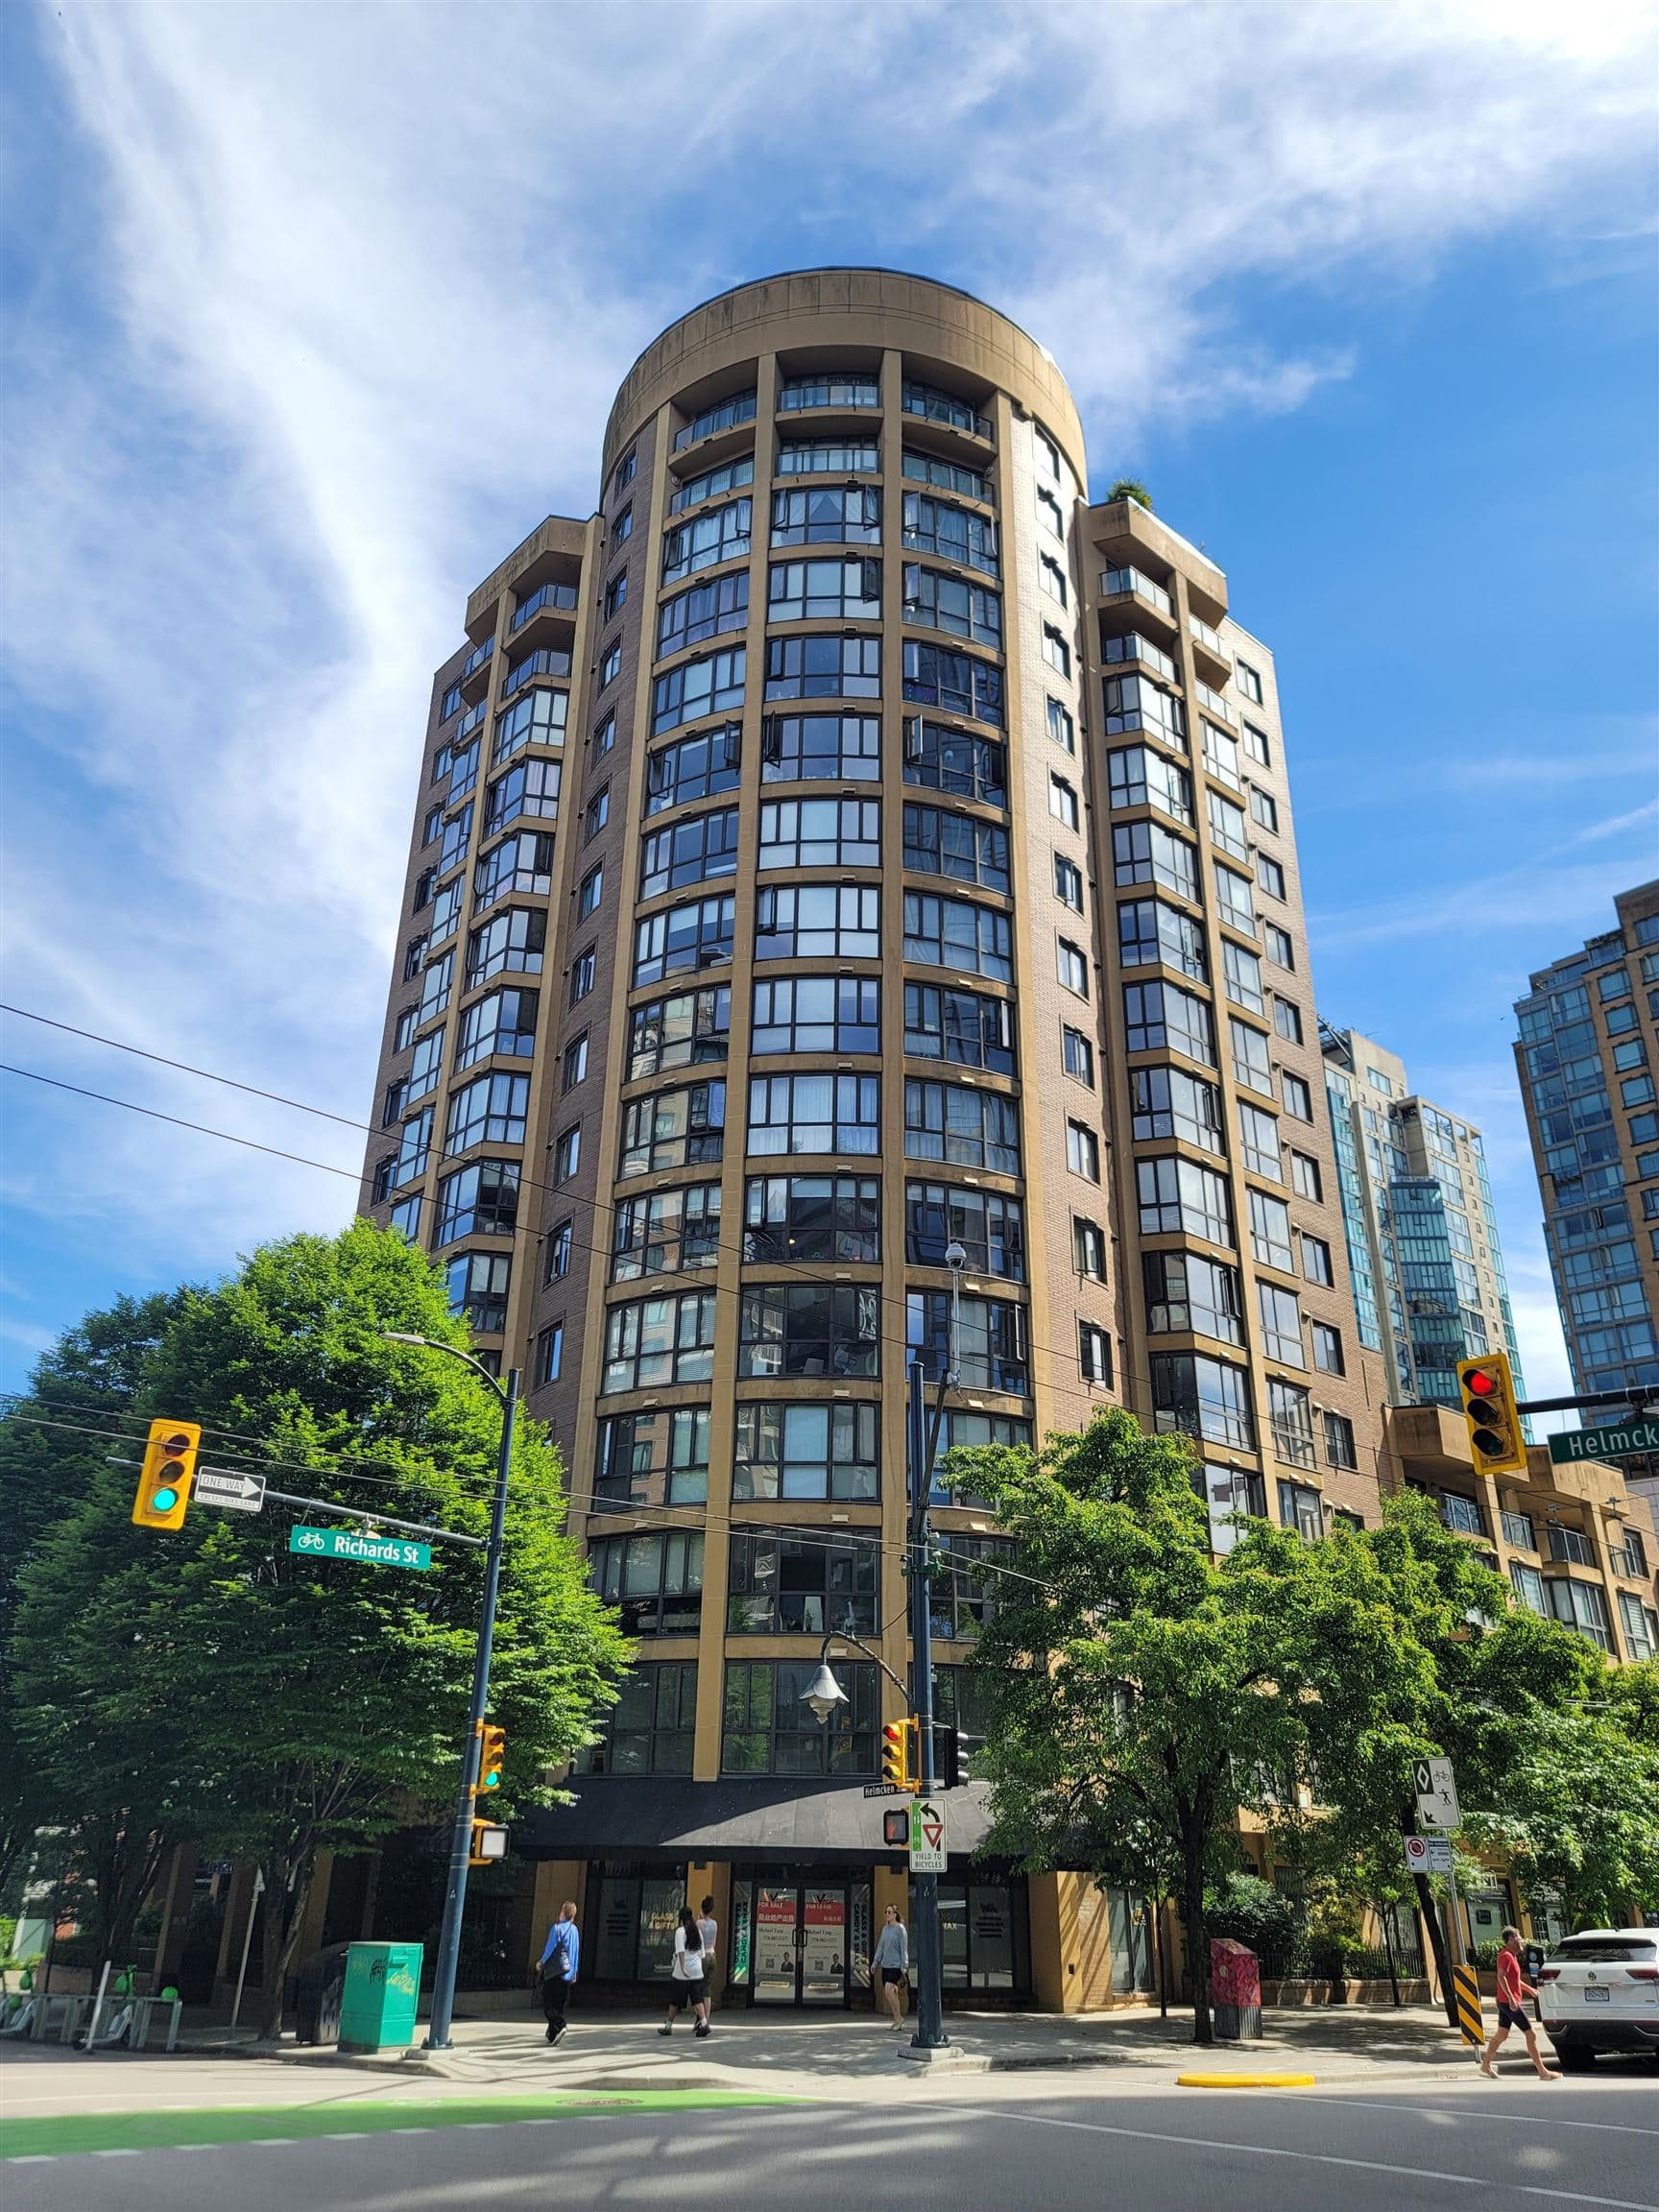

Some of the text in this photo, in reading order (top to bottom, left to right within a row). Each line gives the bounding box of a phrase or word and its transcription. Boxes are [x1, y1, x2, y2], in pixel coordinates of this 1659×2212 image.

[203, 1476, 246, 1491] ONE WAY
[334, 1536, 420, 1564] Richards St
[865, 1786, 895, 1796] Helmcken
